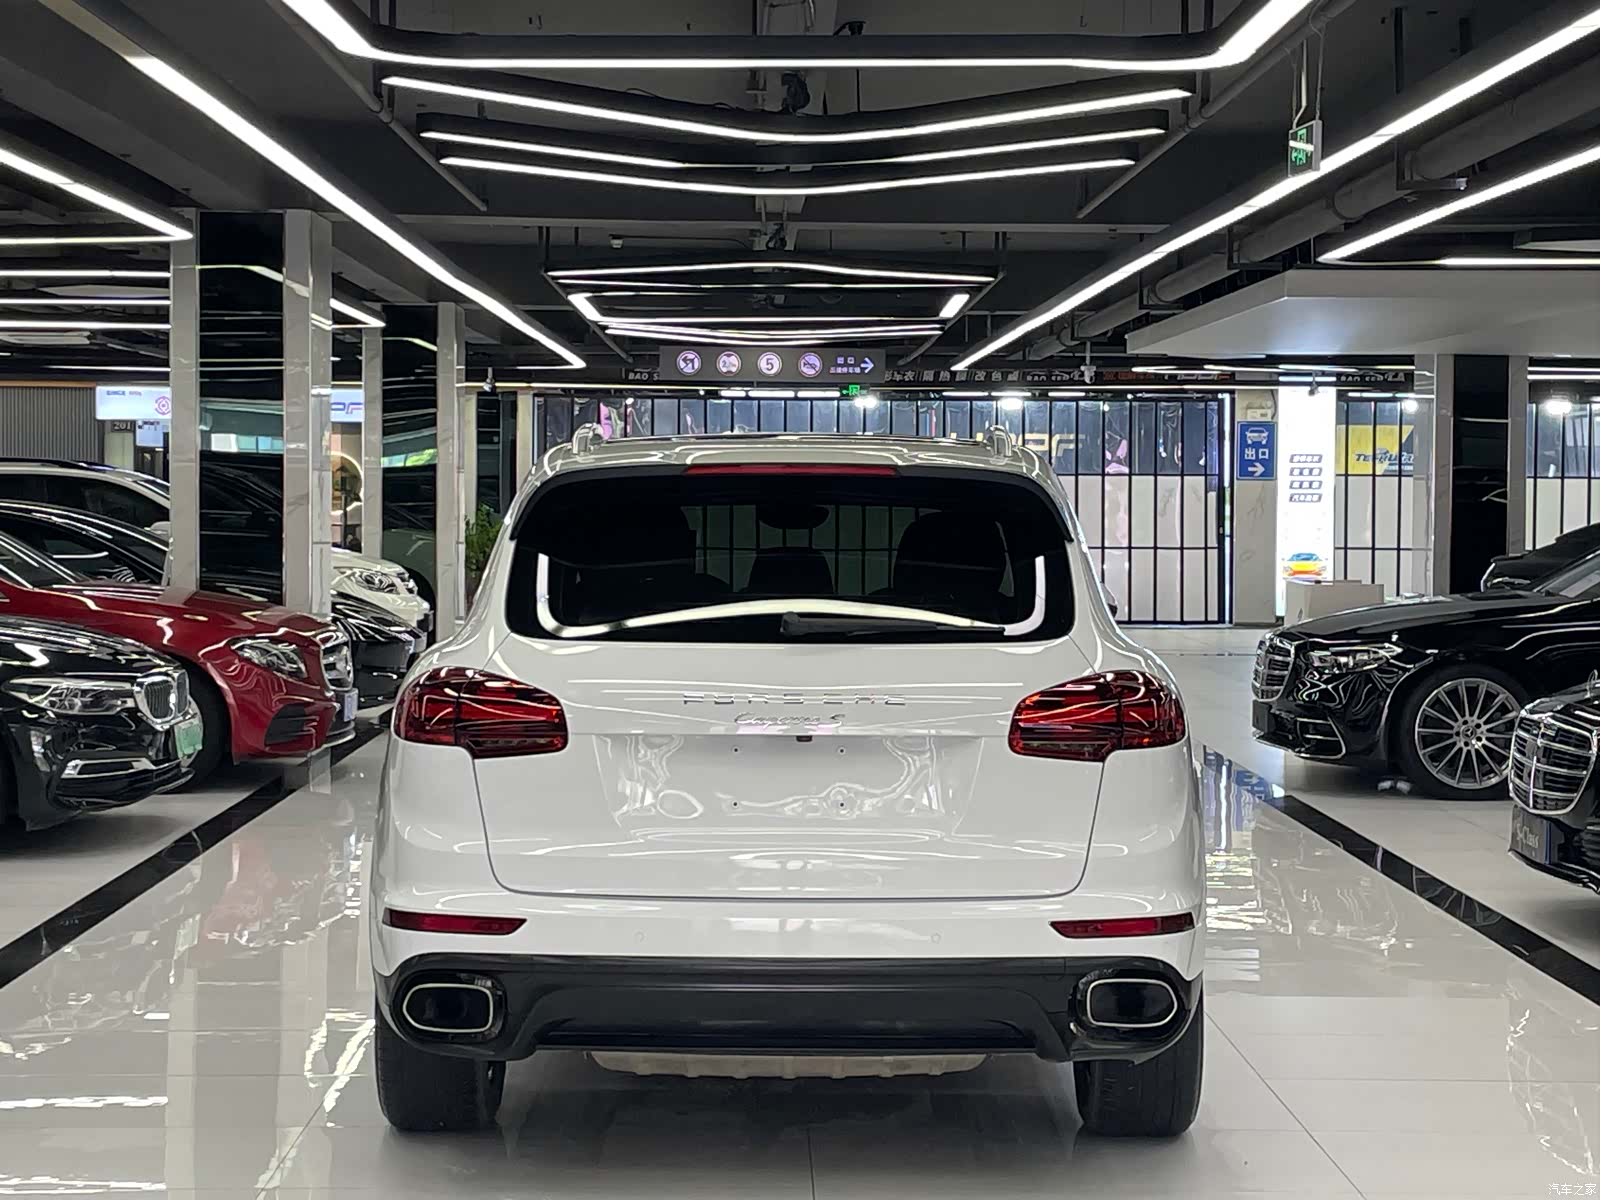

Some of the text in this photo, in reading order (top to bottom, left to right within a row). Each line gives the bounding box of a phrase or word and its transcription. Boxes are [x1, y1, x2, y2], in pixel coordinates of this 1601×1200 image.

[766, 358, 775, 371] 5
[628, 372, 649, 381] BAO
[1244, 447, 1269, 460] 出口
[734, 712, 846, 729] Cayenne S
